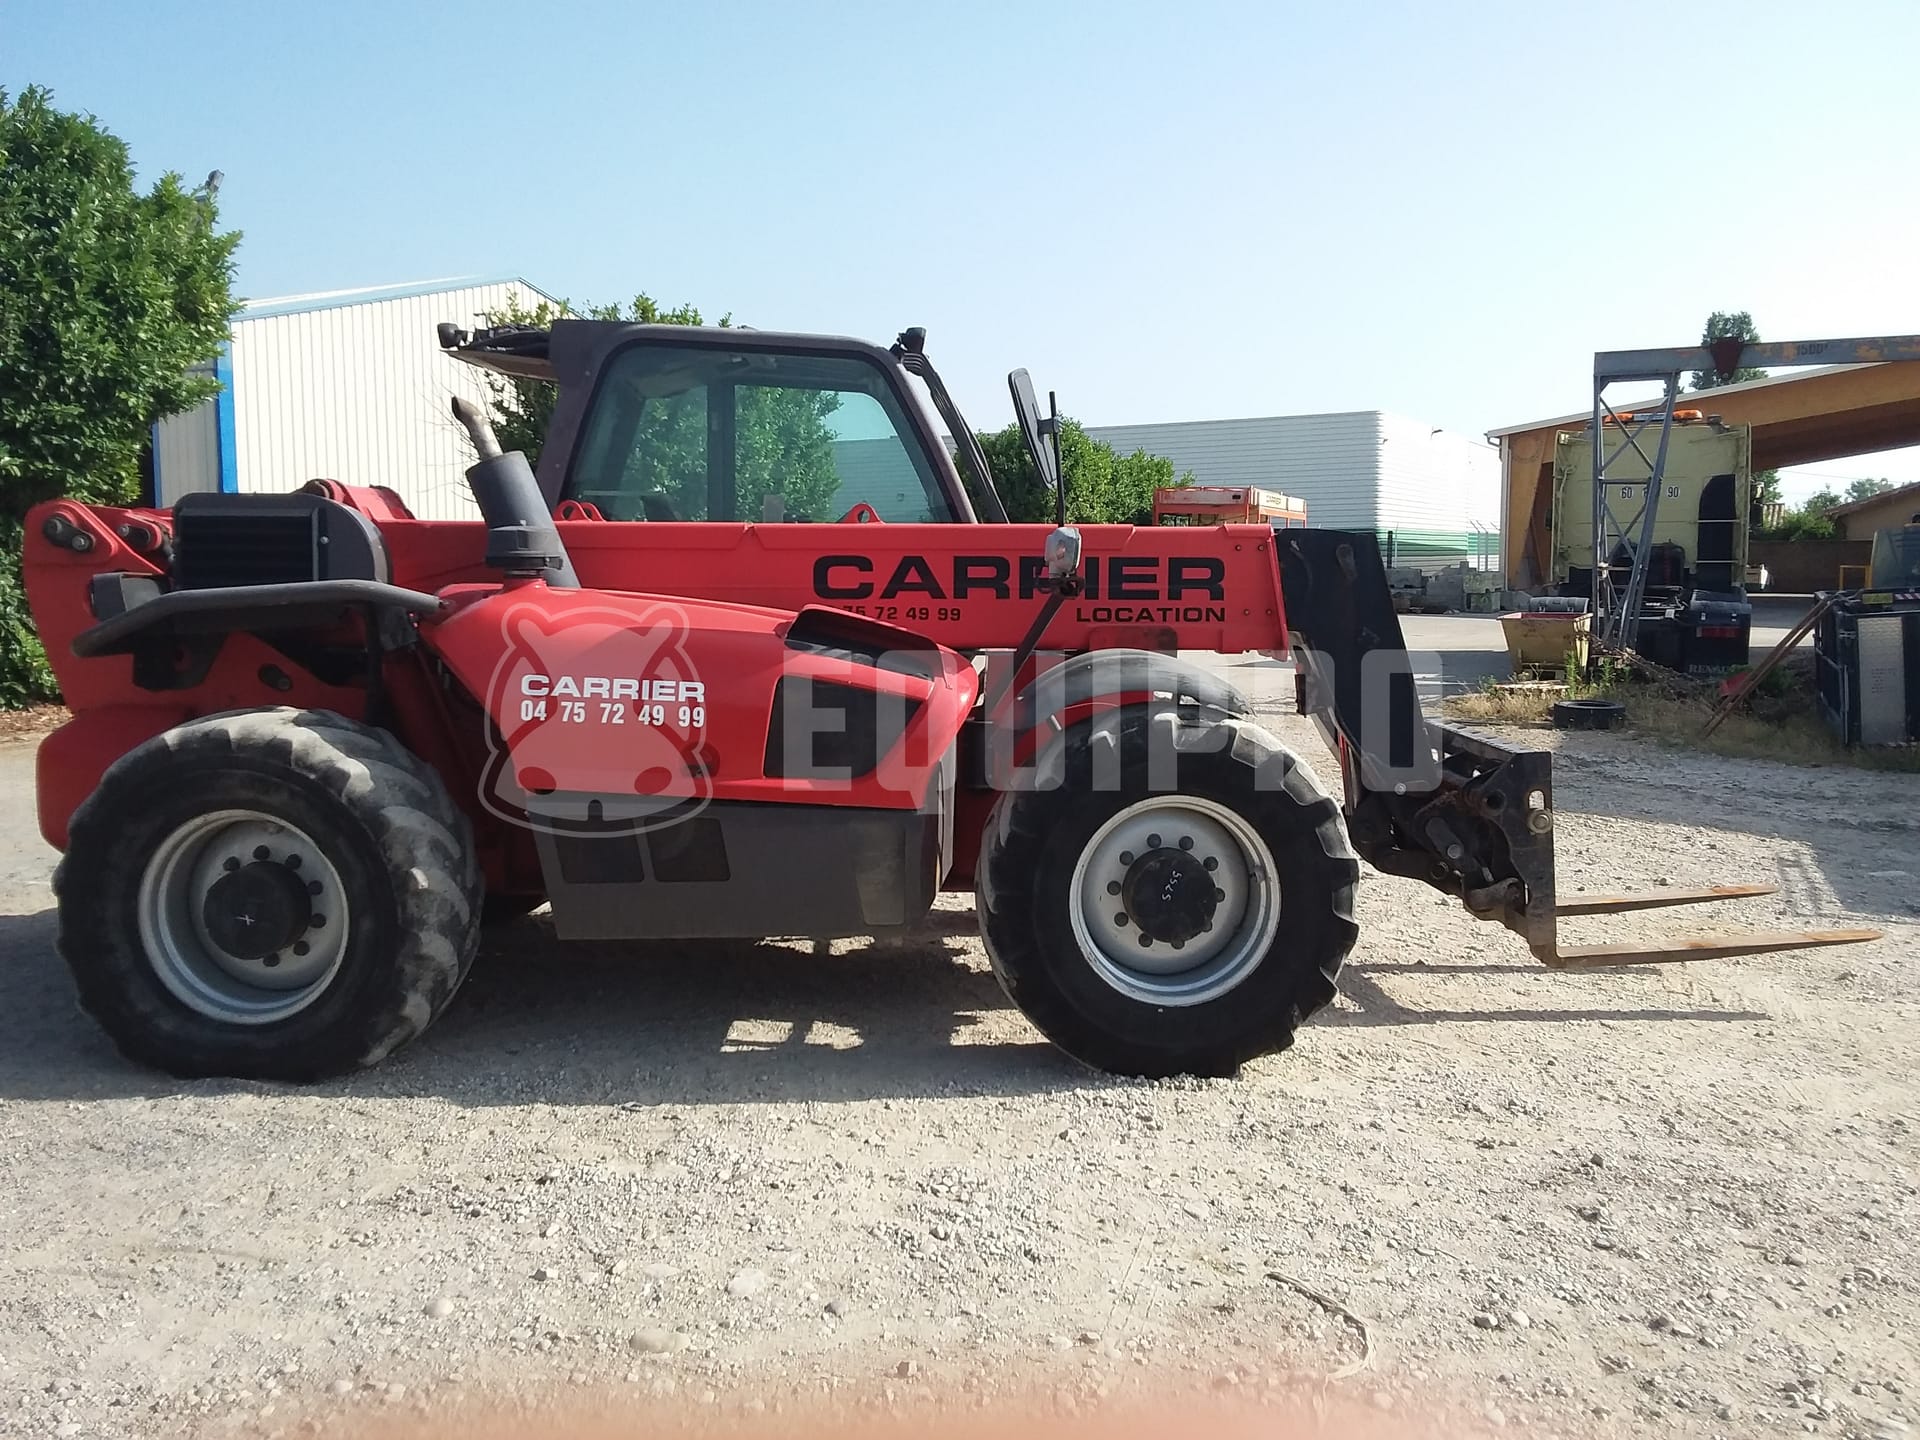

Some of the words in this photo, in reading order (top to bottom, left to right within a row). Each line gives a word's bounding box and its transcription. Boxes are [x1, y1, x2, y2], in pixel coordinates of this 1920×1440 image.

[1621, 487, 1633, 499] 60
[1667, 486, 1679, 498] 90
[875, 606, 898, 620] 72
[906, 607, 930, 620] 49
[937, 607, 961, 621] 99
[1076, 607, 1226, 622] LOCATION
[521, 674, 706, 703] CARRIER
[520, 700, 547, 721] 04
[561, 702, 586, 723] 75
[600, 703, 625, 724] 72
[638, 705, 665, 726] 49
[678, 706, 706, 728] 99
